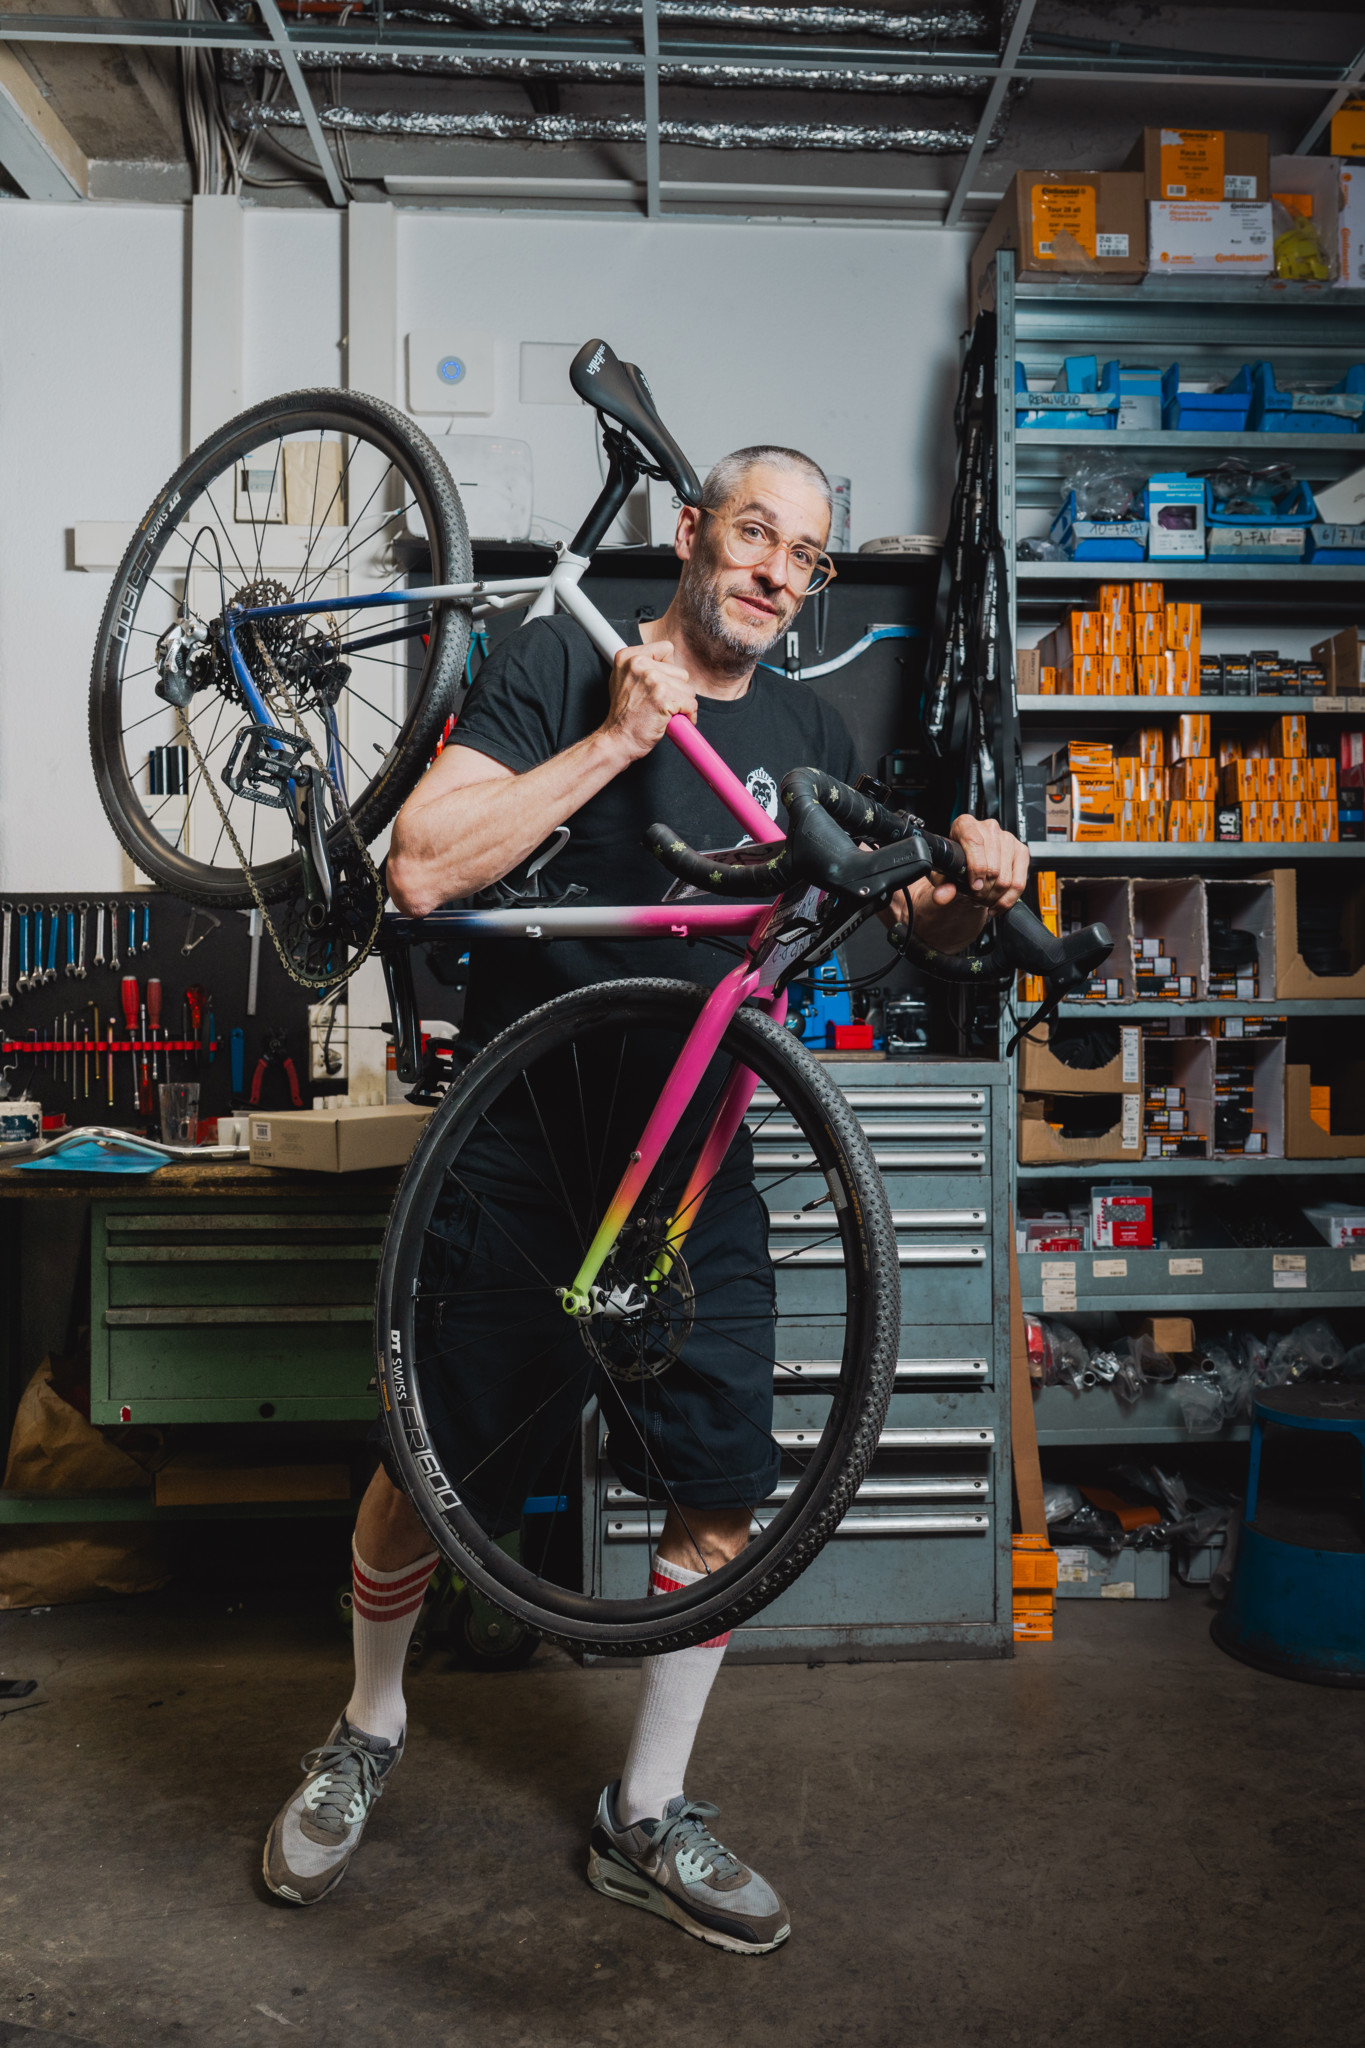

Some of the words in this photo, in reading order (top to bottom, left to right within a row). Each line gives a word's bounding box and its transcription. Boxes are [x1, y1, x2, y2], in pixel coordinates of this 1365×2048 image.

[1215, 253, 1264, 263] Continental
[168, 492, 182, 512] DT
[147, 512, 168, 544] SWISS
[1218, 814, 1236, 833] 18
[820, 920, 858, 956] SRAM
[391, 1330, 401, 1353] DT
[392, 1358, 407, 1400] SWISS
